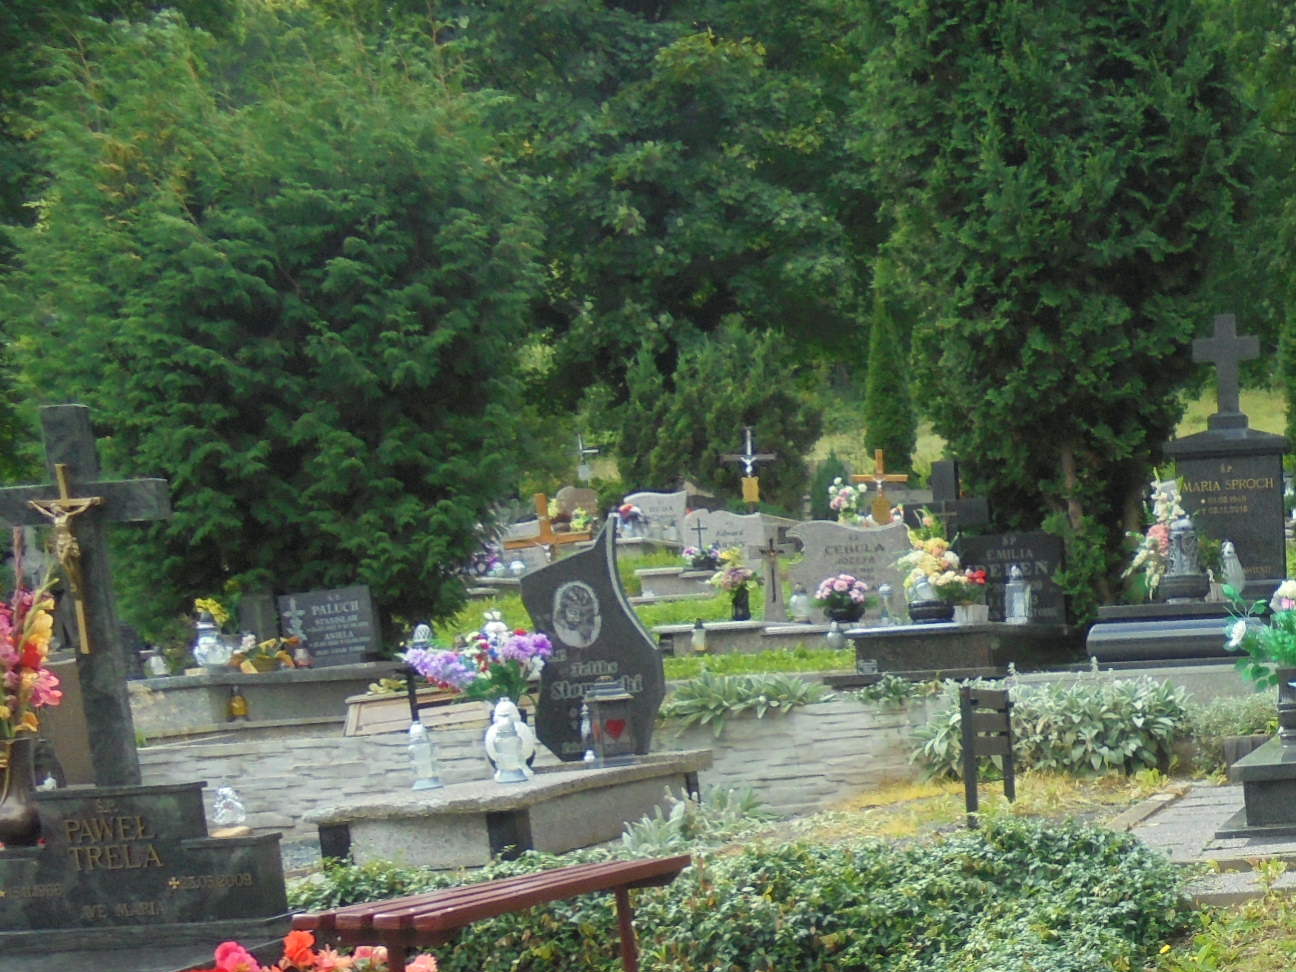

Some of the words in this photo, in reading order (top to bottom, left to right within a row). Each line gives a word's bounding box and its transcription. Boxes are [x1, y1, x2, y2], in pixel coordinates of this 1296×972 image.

[1182, 480, 1221, 493] MARIA
[1225, 478, 1274, 490] SPROCH
[986, 549, 1035, 560] EMILIA
[311, 600, 360, 616] PALUCH
[64, 815, 158, 844] PAWEŁ
[68, 844, 165, 872] TRELA
